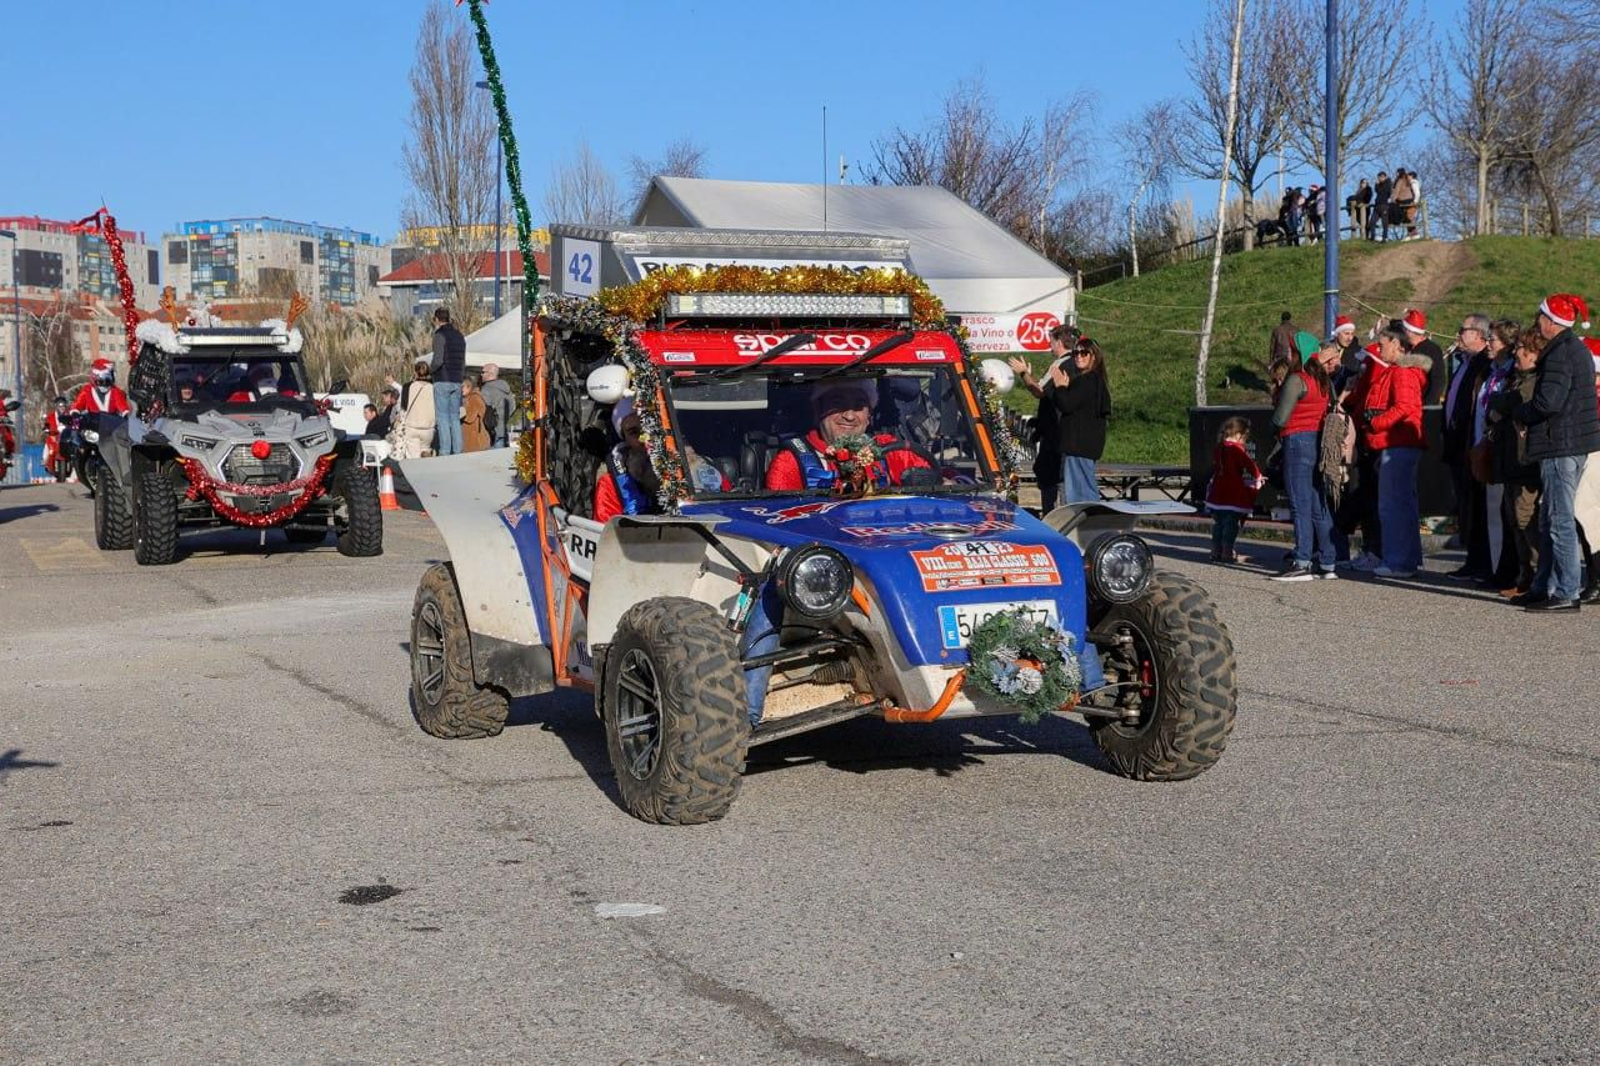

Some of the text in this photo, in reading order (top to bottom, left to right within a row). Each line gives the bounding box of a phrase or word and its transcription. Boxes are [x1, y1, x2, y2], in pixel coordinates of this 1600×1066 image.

[569, 253, 592, 284] 42
[981, 328, 1005, 338] Vino
[964, 556, 991, 568] BAJA
[991, 555, 1030, 567] CLASSIC
[1030, 553, 1050, 566] 500
